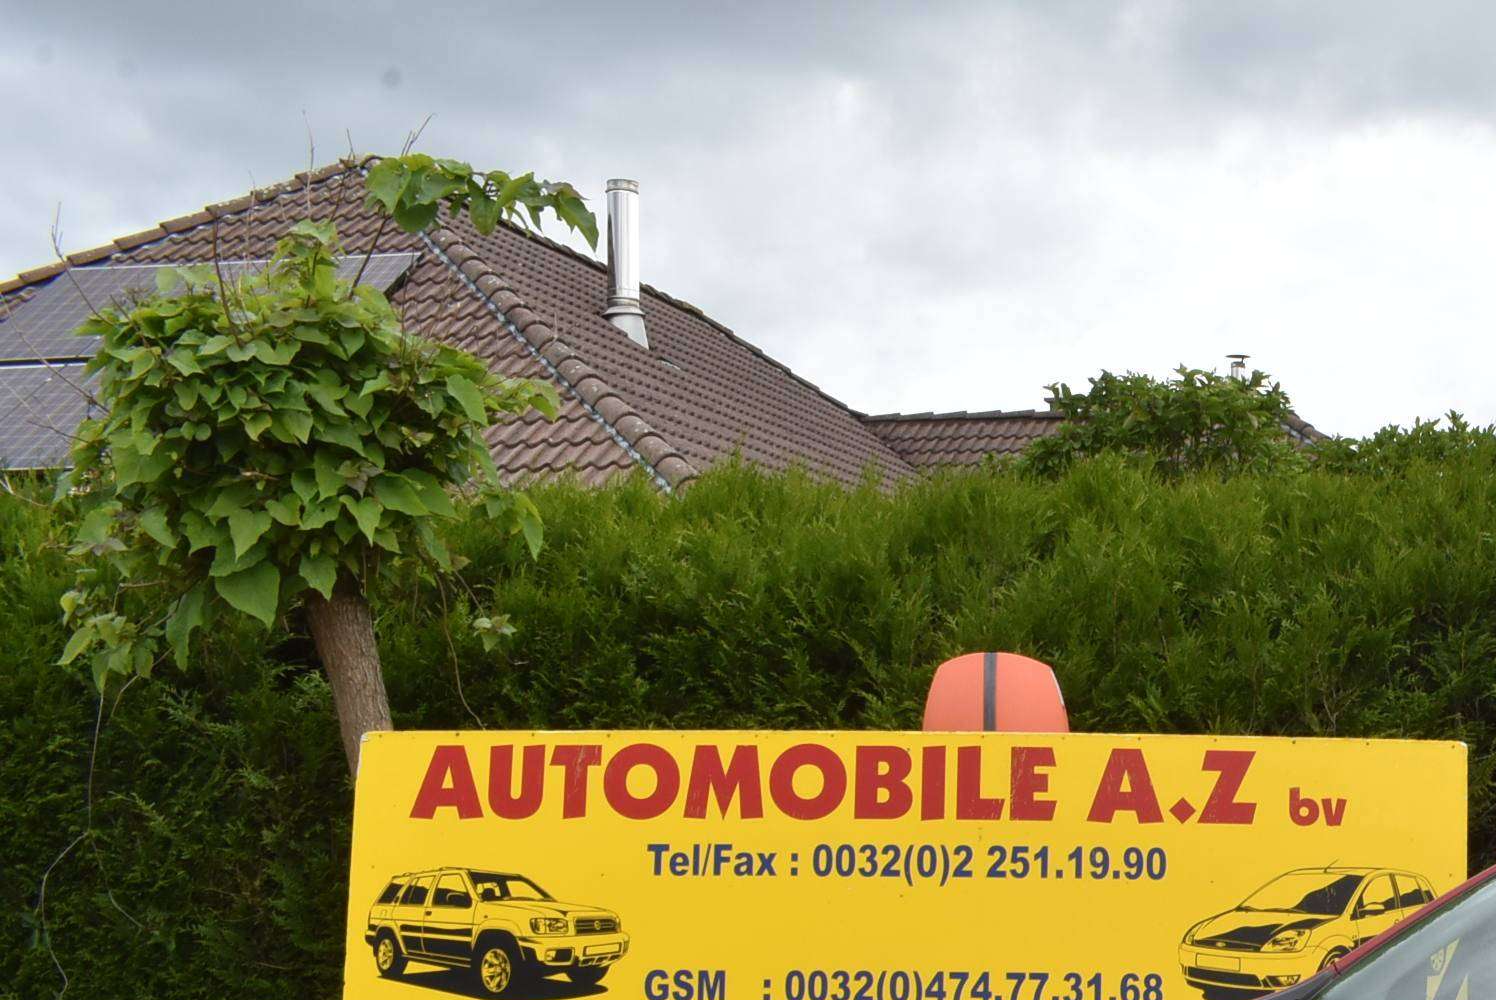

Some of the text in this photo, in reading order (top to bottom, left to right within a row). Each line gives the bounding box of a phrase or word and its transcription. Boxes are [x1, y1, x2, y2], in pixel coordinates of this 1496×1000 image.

[409, 743, 1348, 827] AUTOMOBILE A.Z bv
[646, 843, 1167, 887] Tel/Fax : 0032(0)2 251.19.90
